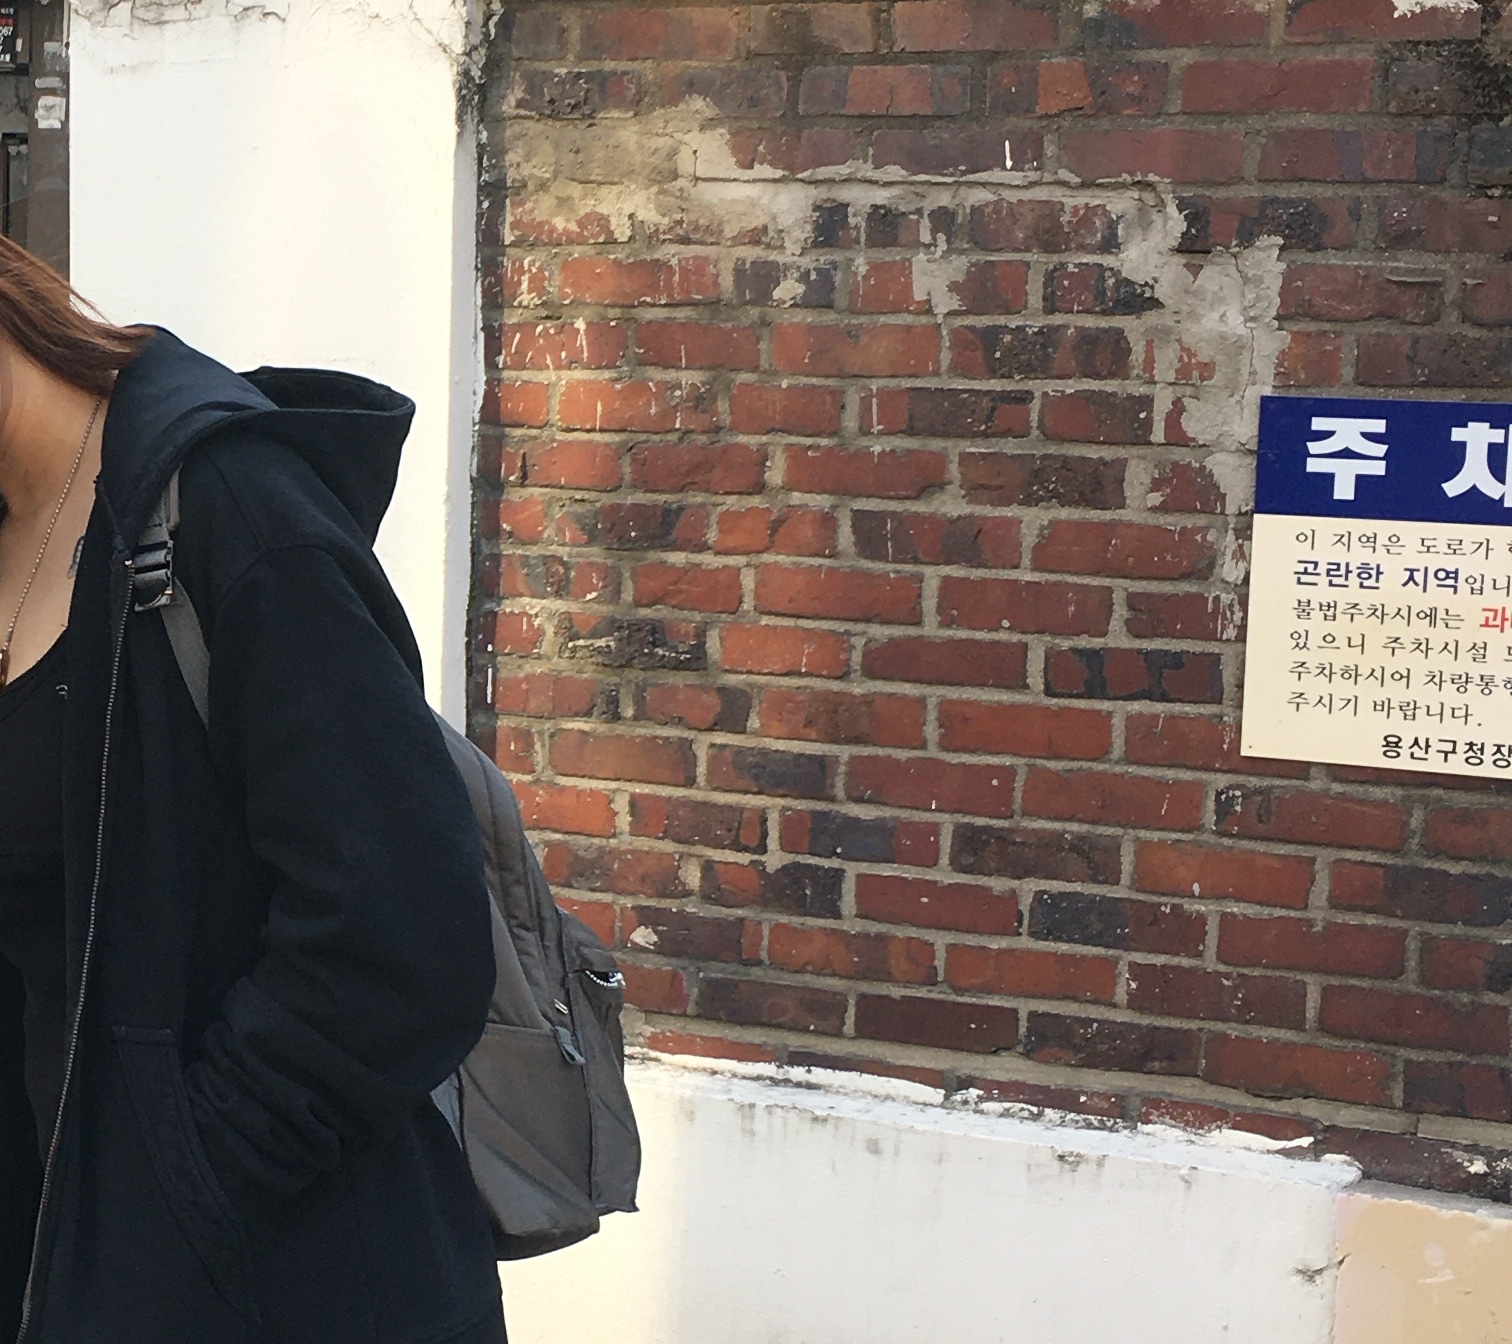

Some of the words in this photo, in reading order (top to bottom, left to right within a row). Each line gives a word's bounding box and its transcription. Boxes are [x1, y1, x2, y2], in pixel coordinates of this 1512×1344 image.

[1295, 528, 1316, 551] 이
[1331, 530, 1406, 555] 지역은
[1416, 537, 1495, 560] 도로가
[1293, 559, 1384, 590] 곤란한
[1292, 599, 1465, 629] 불법주차시에는
[1289, 629, 1366, 655] 있으니
[1382, 636, 1488, 664] 주차시설
[1288, 660, 1411, 690] 주차하시어
[1287, 691, 1359, 717] 주시기
[1373, 697, 1482, 727] 바랍니다.
[1381, 734, 1512, 769] 용산구청장
